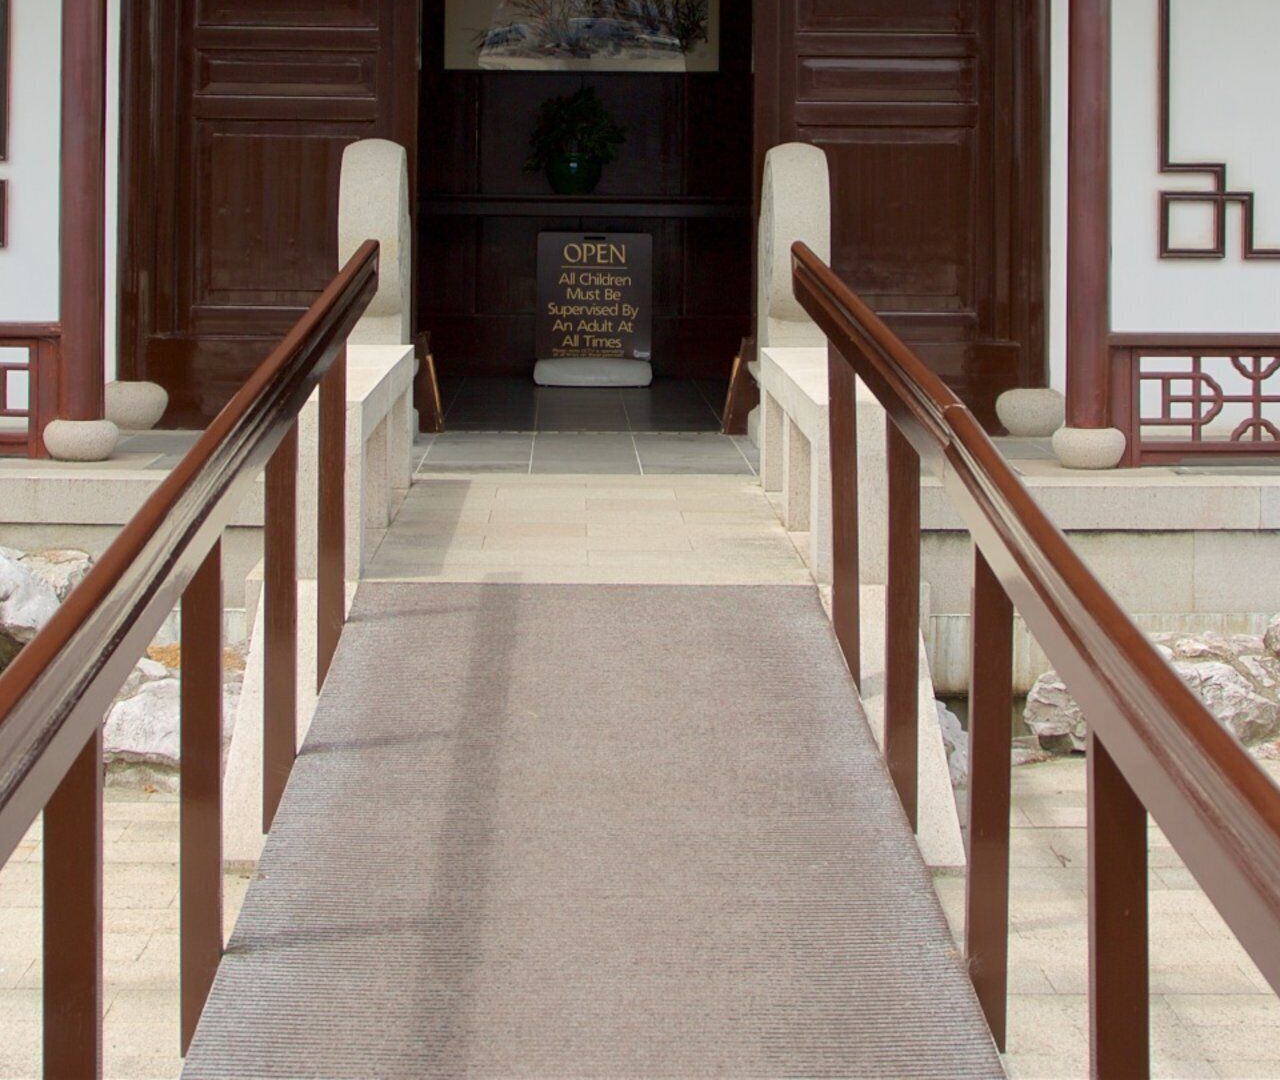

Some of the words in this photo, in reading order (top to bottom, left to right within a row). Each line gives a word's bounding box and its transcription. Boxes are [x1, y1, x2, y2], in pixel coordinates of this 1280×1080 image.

[563, 243, 626, 263] OPEN
[559, 273, 575, 285] All
[580, 273, 631, 286] Children
[567, 288, 600, 300] Must
[605, 289, 621, 301] Be
[548, 302, 618, 317] Supervised
[622, 304, 639, 319] By
[552, 320, 572, 331] An
[577, 320, 612, 332] Adult
[618, 321, 633, 333] At
[562, 335, 579, 347] All
[584, 335, 622, 348] Times
